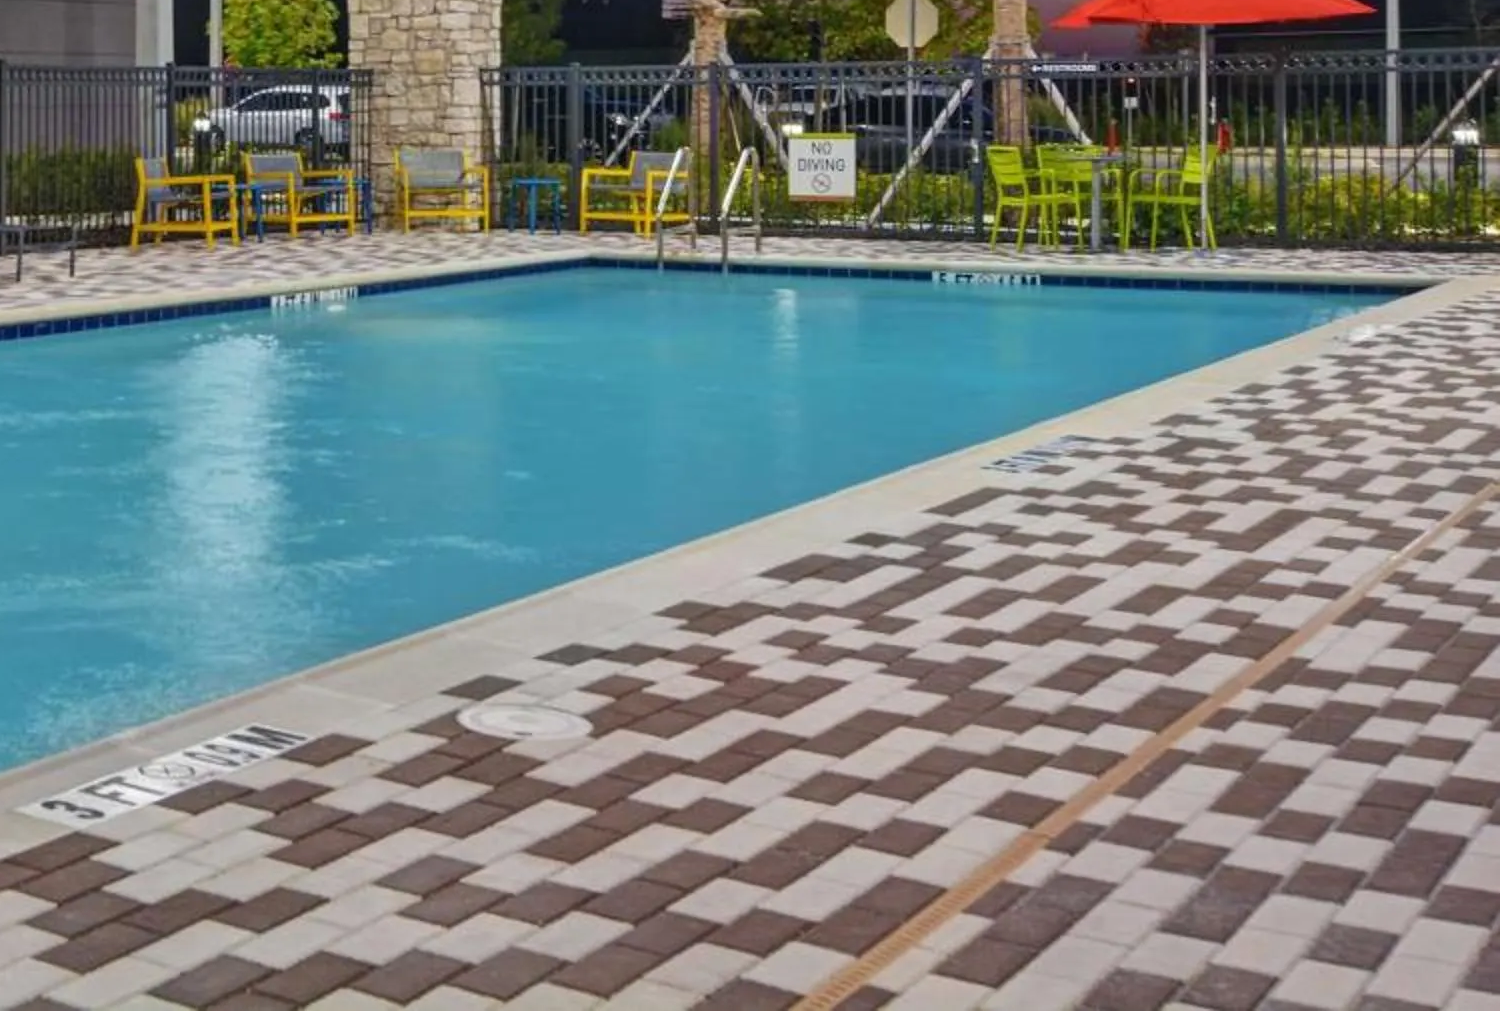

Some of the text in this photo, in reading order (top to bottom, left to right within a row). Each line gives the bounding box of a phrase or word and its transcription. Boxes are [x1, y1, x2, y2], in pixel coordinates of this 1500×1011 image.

[811, 141, 833, 155] NO
[797, 158, 846, 172] DIVING
[40, 800, 105, 820] 3
[79, 776, 167, 807] FT
[226, 725, 308, 750] M
